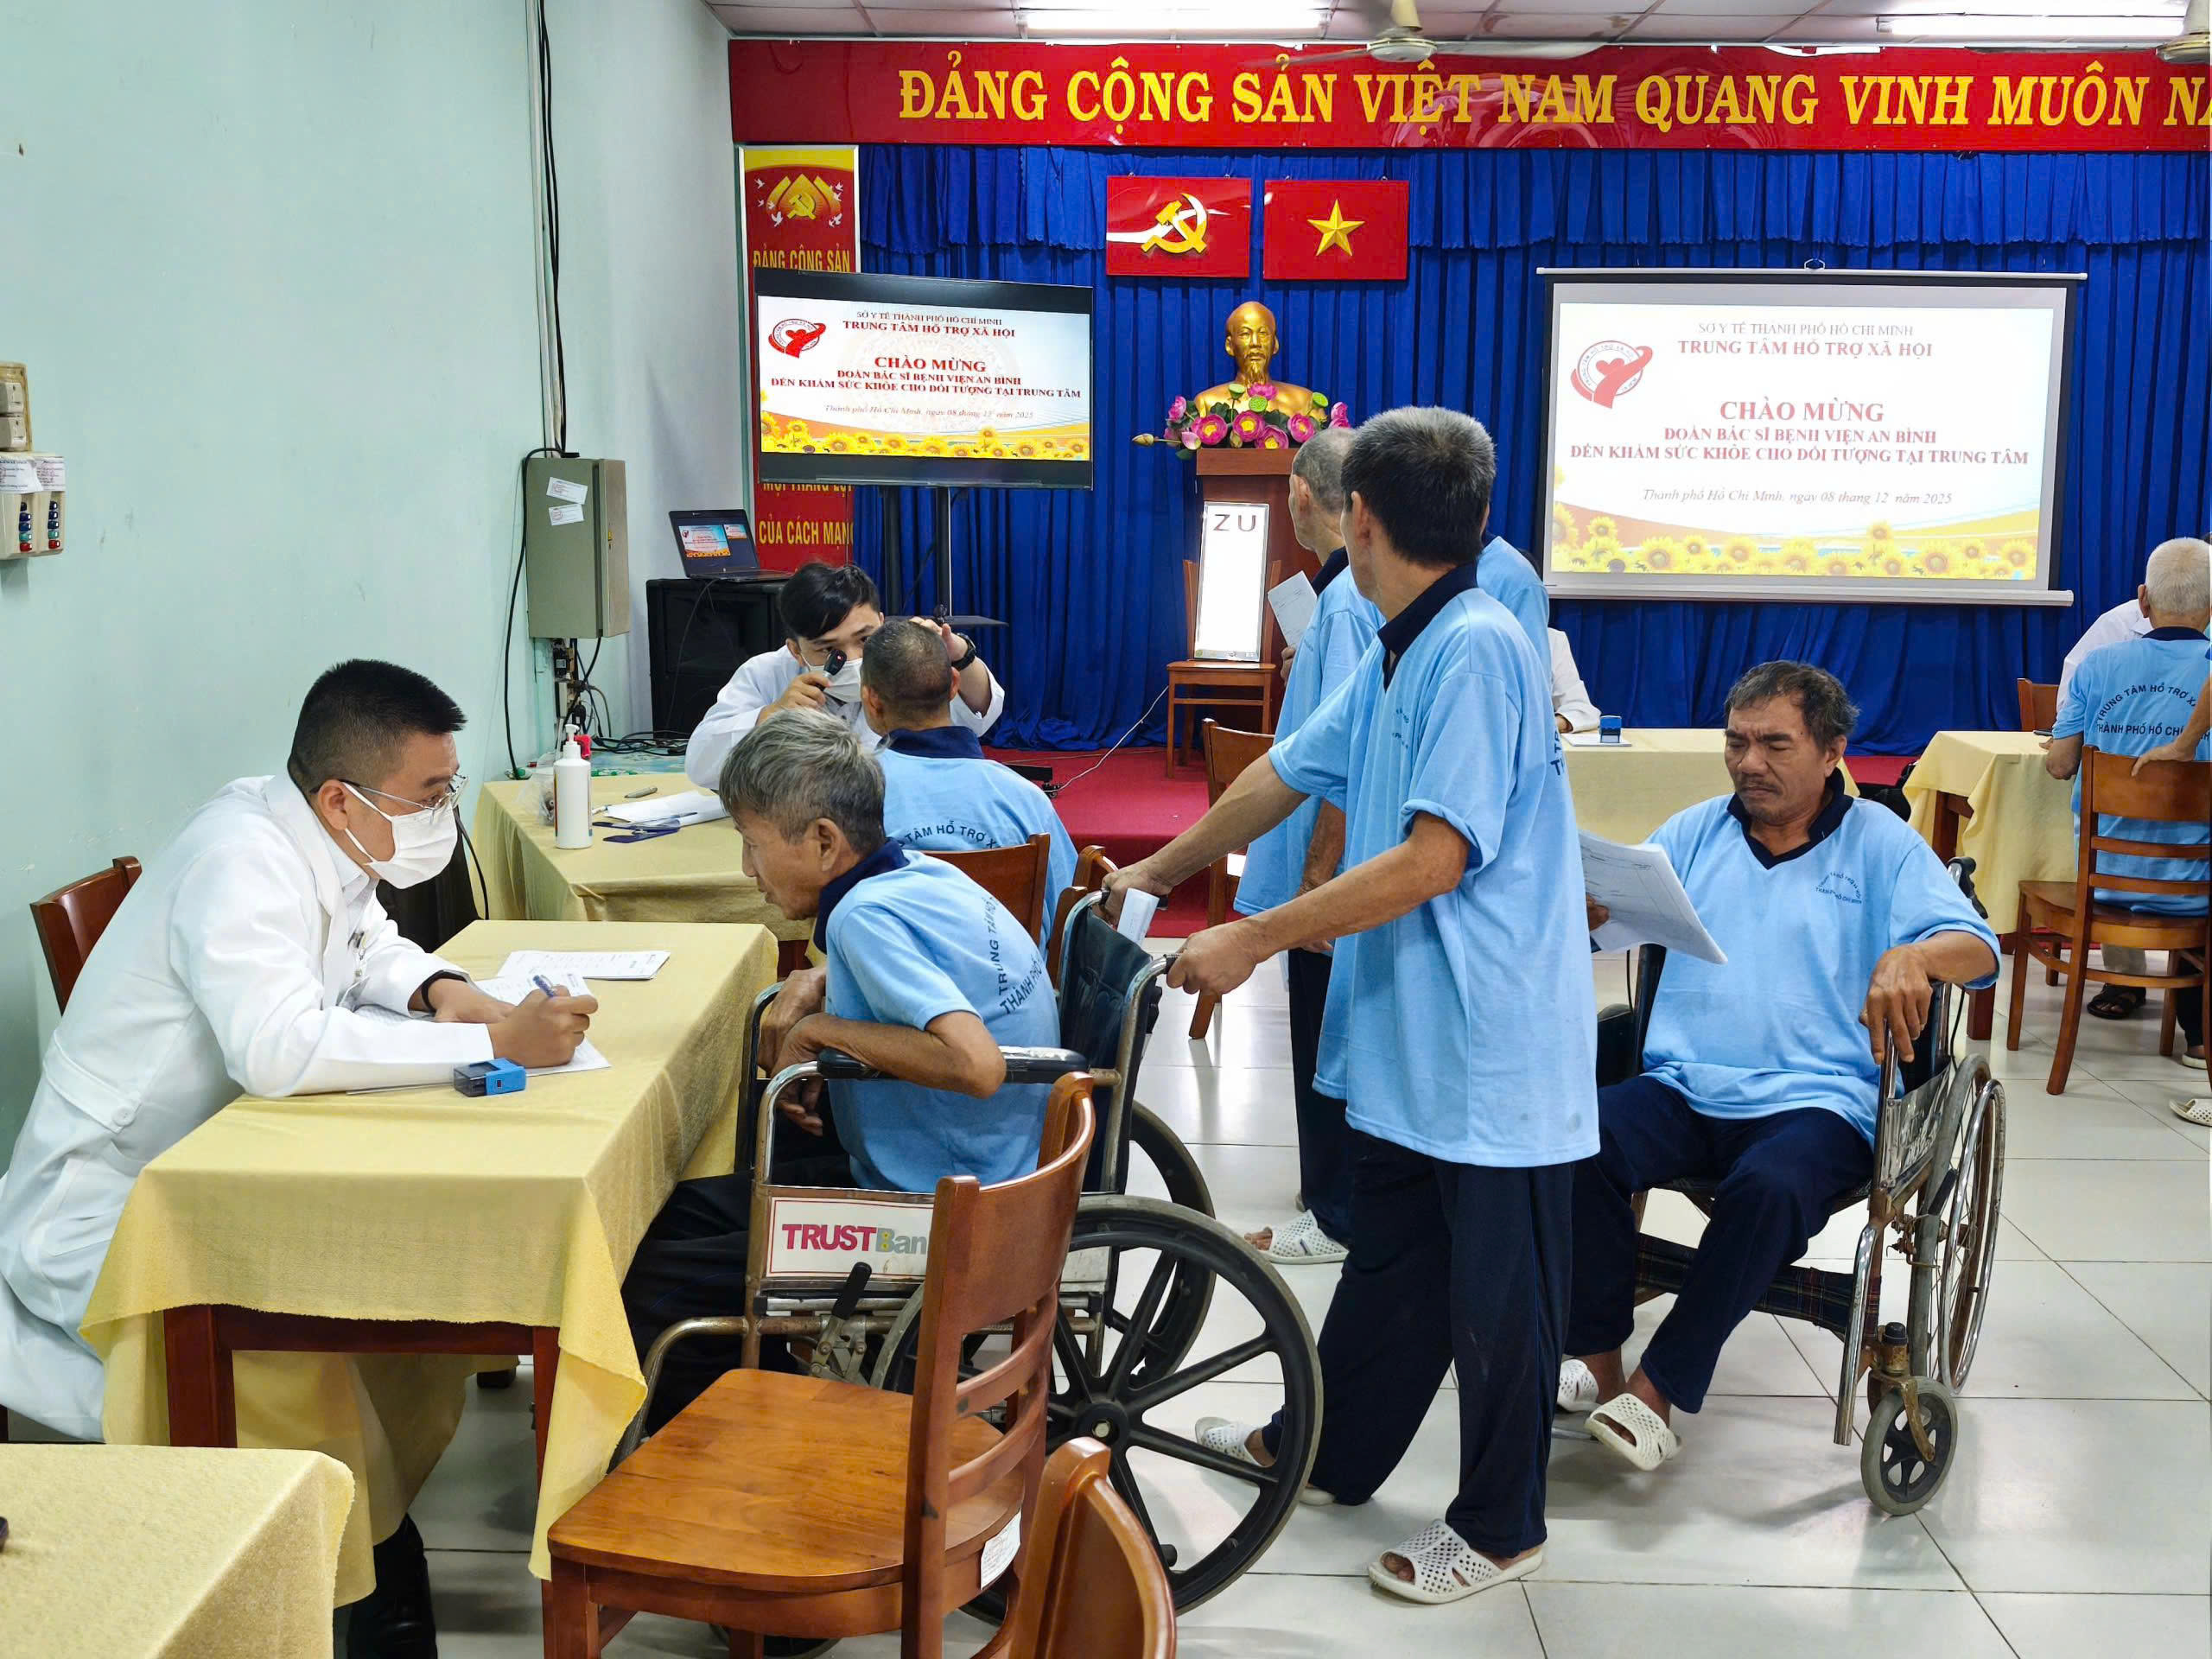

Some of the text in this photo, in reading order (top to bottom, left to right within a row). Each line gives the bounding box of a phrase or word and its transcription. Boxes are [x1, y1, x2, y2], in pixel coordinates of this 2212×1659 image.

[899, 50, 1048, 122] ĐẢNG
[1067, 55, 1213, 135] CỘNG
[1232, 54, 1338, 124] SẢN
[1353, 59, 1482, 137] VIỆT
[1498, 74, 1618, 124] NAM
[1636, 74, 1819, 132] QUANG
[1840, 75, 1972, 125] VINH
[1987, 60, 2151, 125] MUÔN
[843, 321, 887, 331] TRUNG
[891, 321, 919, 333] TÂM
[943, 326, 969, 337] TRỢ
[993, 328, 1016, 338] HỘI
[1718, 323, 1727, 334] Y
[1878, 324, 1914, 337] MINH
[1678, 340, 1742, 354] TRUNG
[1747, 337, 1788, 355] TÂM
[1824, 341, 1864, 359] TRỢ
[1899, 343, 1933, 359] HỘI
[874, 355, 987, 372] CHÀO MỪNG
[947, 373, 974, 385] VIỆN
[901, 383, 926, 392] CHO
[995, 387, 1014, 397] TẠI
[1017, 388, 1055, 397] TRUNG
[1056, 388, 1082, 398] TÂM
[1719, 396, 1885, 423] CHÀO MỪNG
[1775, 428, 1820, 444] BỆNH
[1825, 429, 1865, 446] VIỆN
[1867, 430, 1891, 443] AN
[1896, 428, 1936, 444] BÌNH
[1664, 444, 1699, 460] SỨC
[1756, 448, 1792, 461] CHO
[1831, 448, 1891, 465] TƯỢNG
[1895, 449, 1923, 466] TẠI
[1929, 449, 1986, 464] TRUNG
[1991, 448, 2029, 465] TÂM
[1820, 492, 1835, 503] 08
[1874, 492, 1890, 504] 12
[1923, 493, 1953, 505] 2025
[760, 512, 784, 545] CỦA
[787, 515, 820, 545] CÁCH
[2096, 694, 2123, 721] TRUNG
[2168, 686, 2190, 699] TRỢ
[2125, 721, 2147, 735] PHỐ
[960, 826, 986, 842] TRỢ
[989, 939, 1008, 995] TRUNG
[1000, 976, 1035, 1015] THÀNH
[781, 1223, 928, 1255] TRUSTBan
